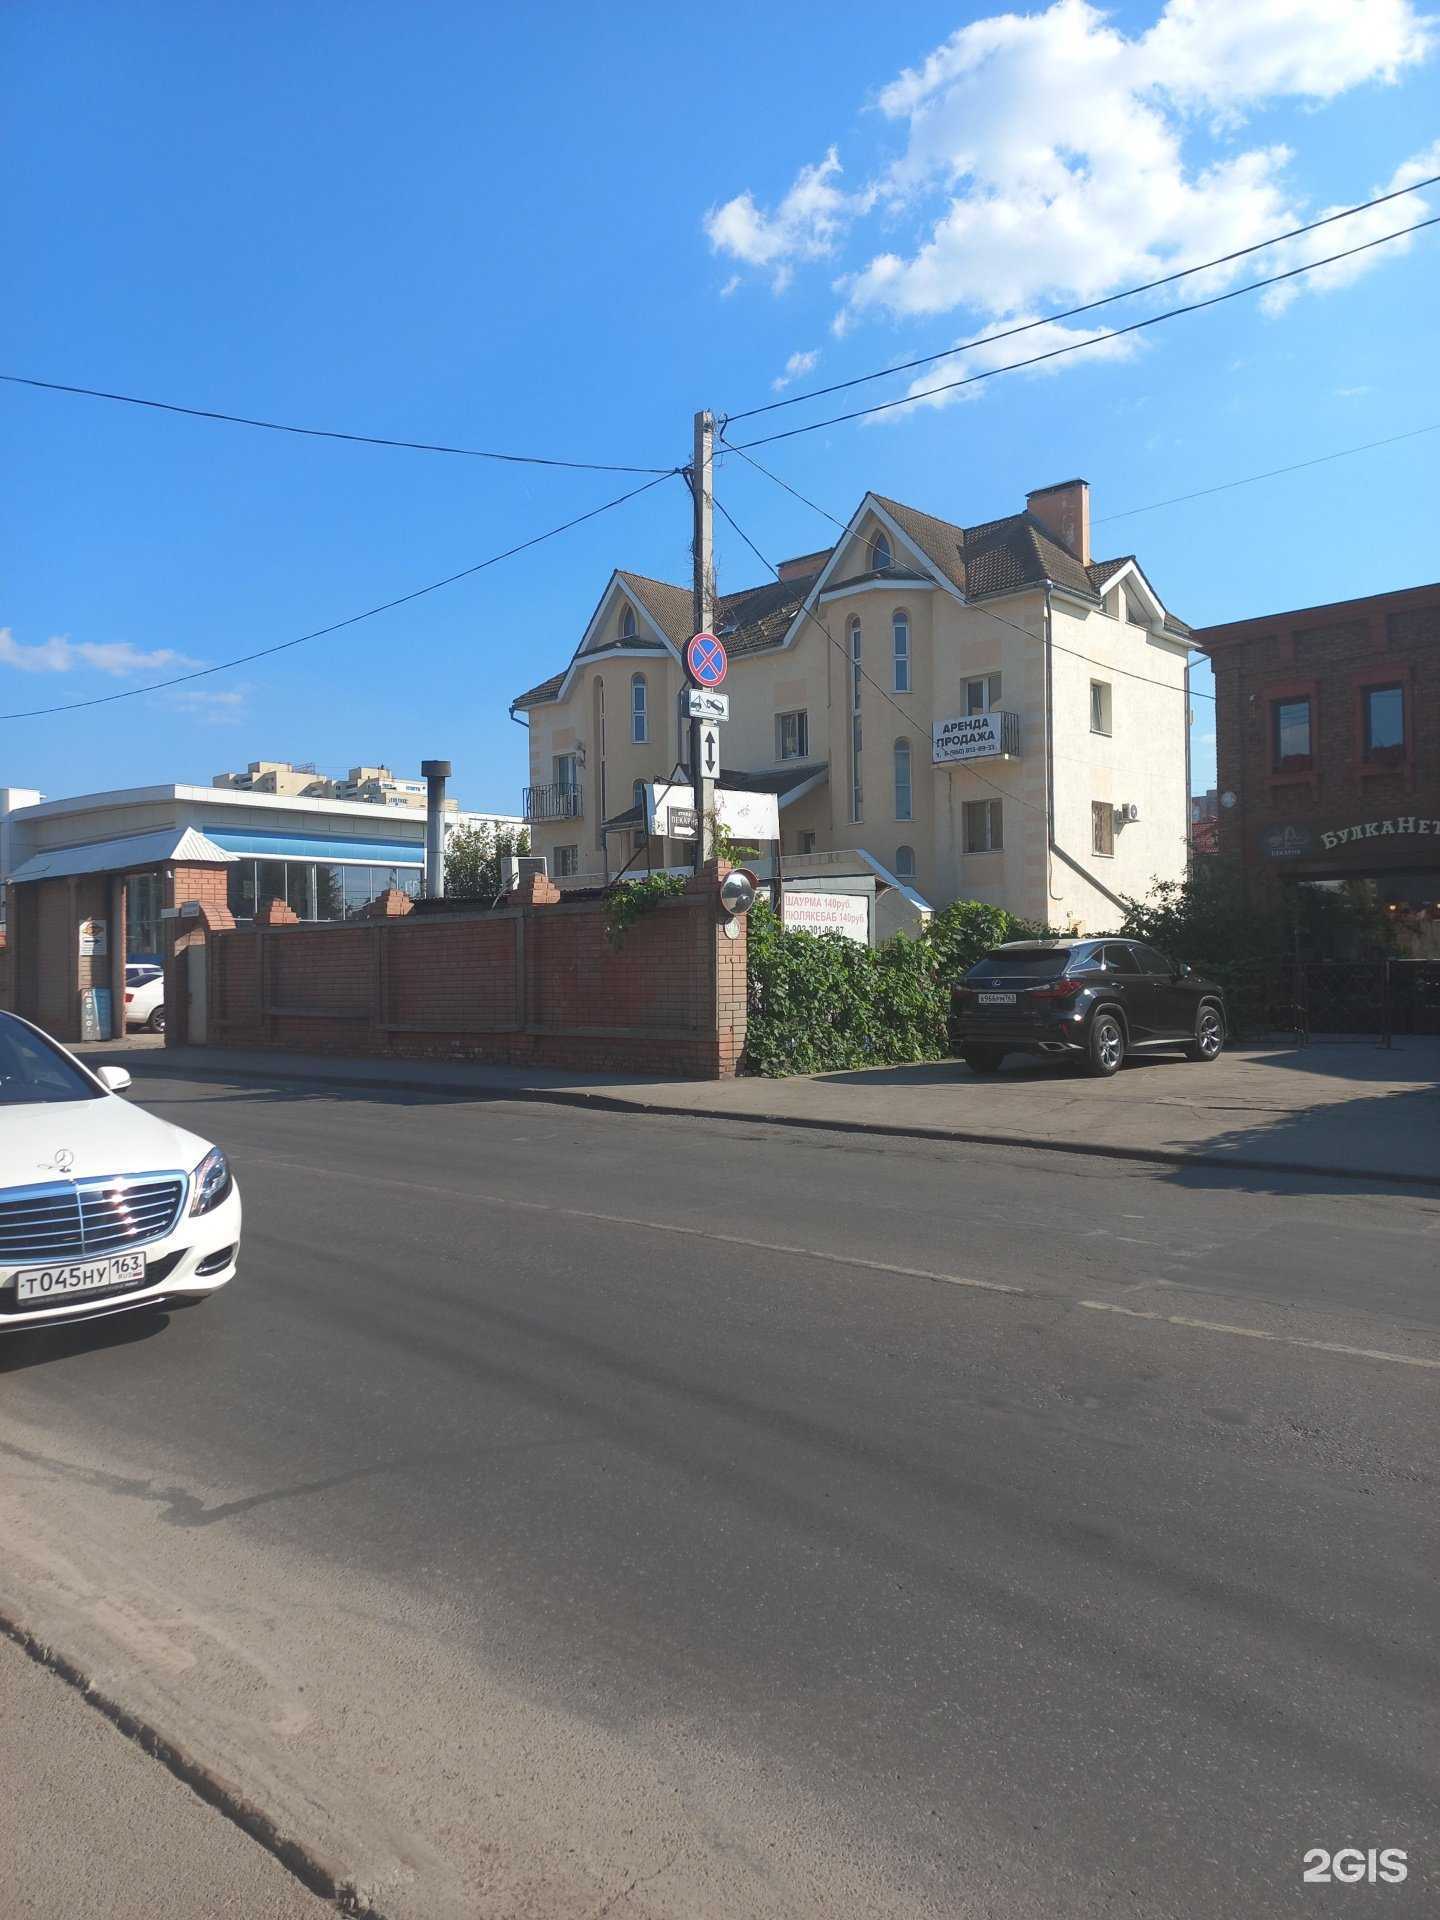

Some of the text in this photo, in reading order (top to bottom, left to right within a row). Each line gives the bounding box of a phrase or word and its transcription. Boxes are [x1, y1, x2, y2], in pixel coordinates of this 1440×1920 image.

[943, 718, 989, 734] АРЕНДА
[936, 731, 995, 748] ПРОДАЖА
[785, 895, 822, 908] ШАУРМА
[26, 1256, 139, 1294] Т045НУ 163
